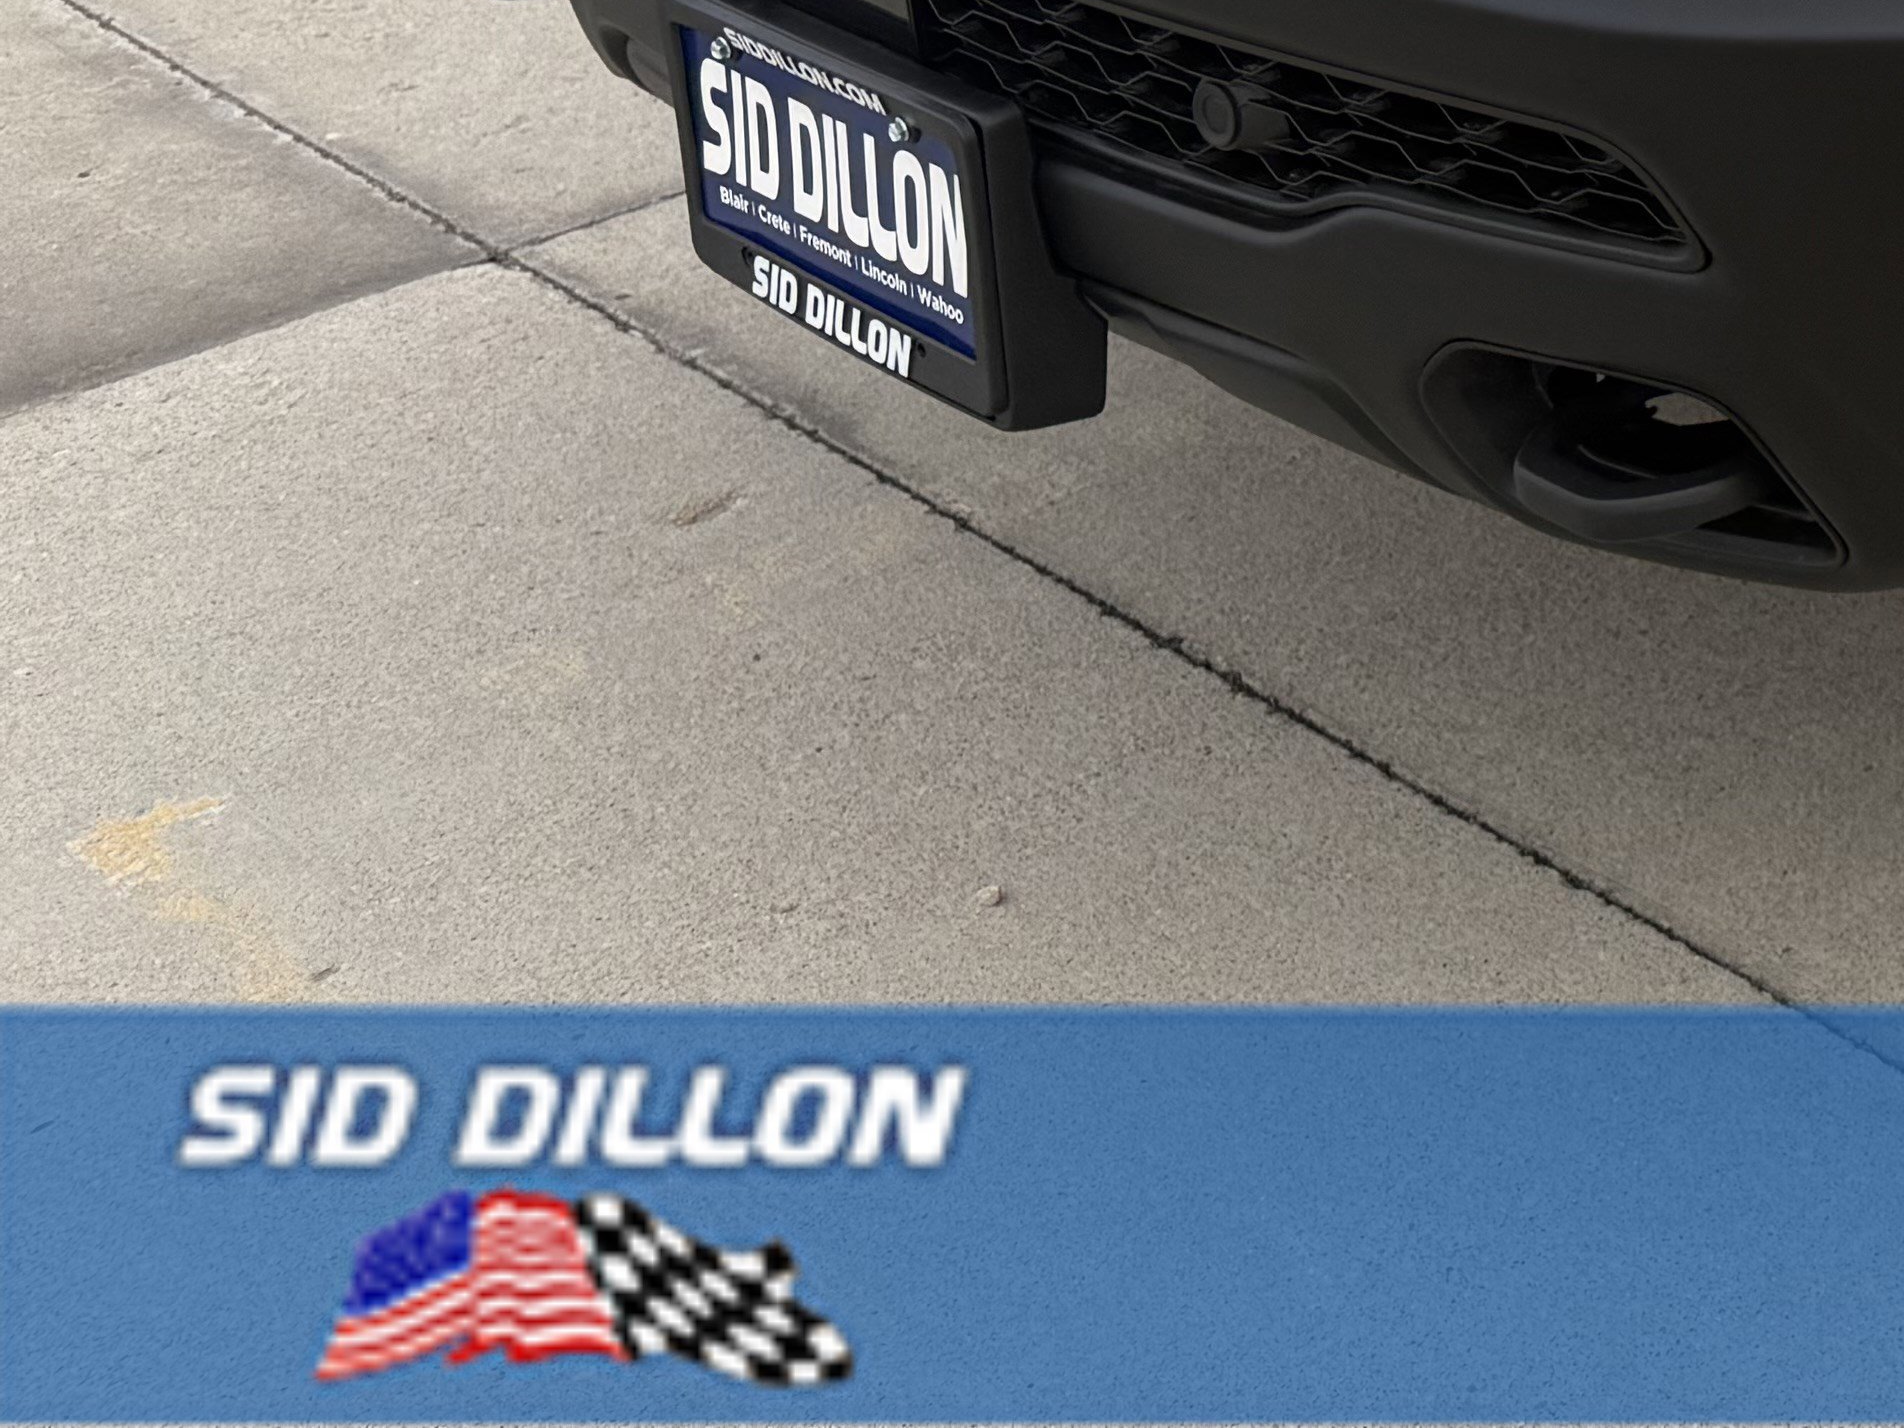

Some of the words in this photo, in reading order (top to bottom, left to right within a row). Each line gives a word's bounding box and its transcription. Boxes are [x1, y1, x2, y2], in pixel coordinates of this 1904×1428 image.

[723, 27, 887, 116] SIDDILLON.COM
[700, 58, 780, 200] SID
[787, 96, 968, 298] DILLON
[719, 185, 749, 214] Blair
[758, 205, 791, 235] Crete
[799, 225, 853, 268] Fremont
[861, 259, 908, 296] Lincoln
[917, 285, 965, 325] Wahoo
[752, 255, 798, 315] SID
[805, 283, 912, 378] DILLON
